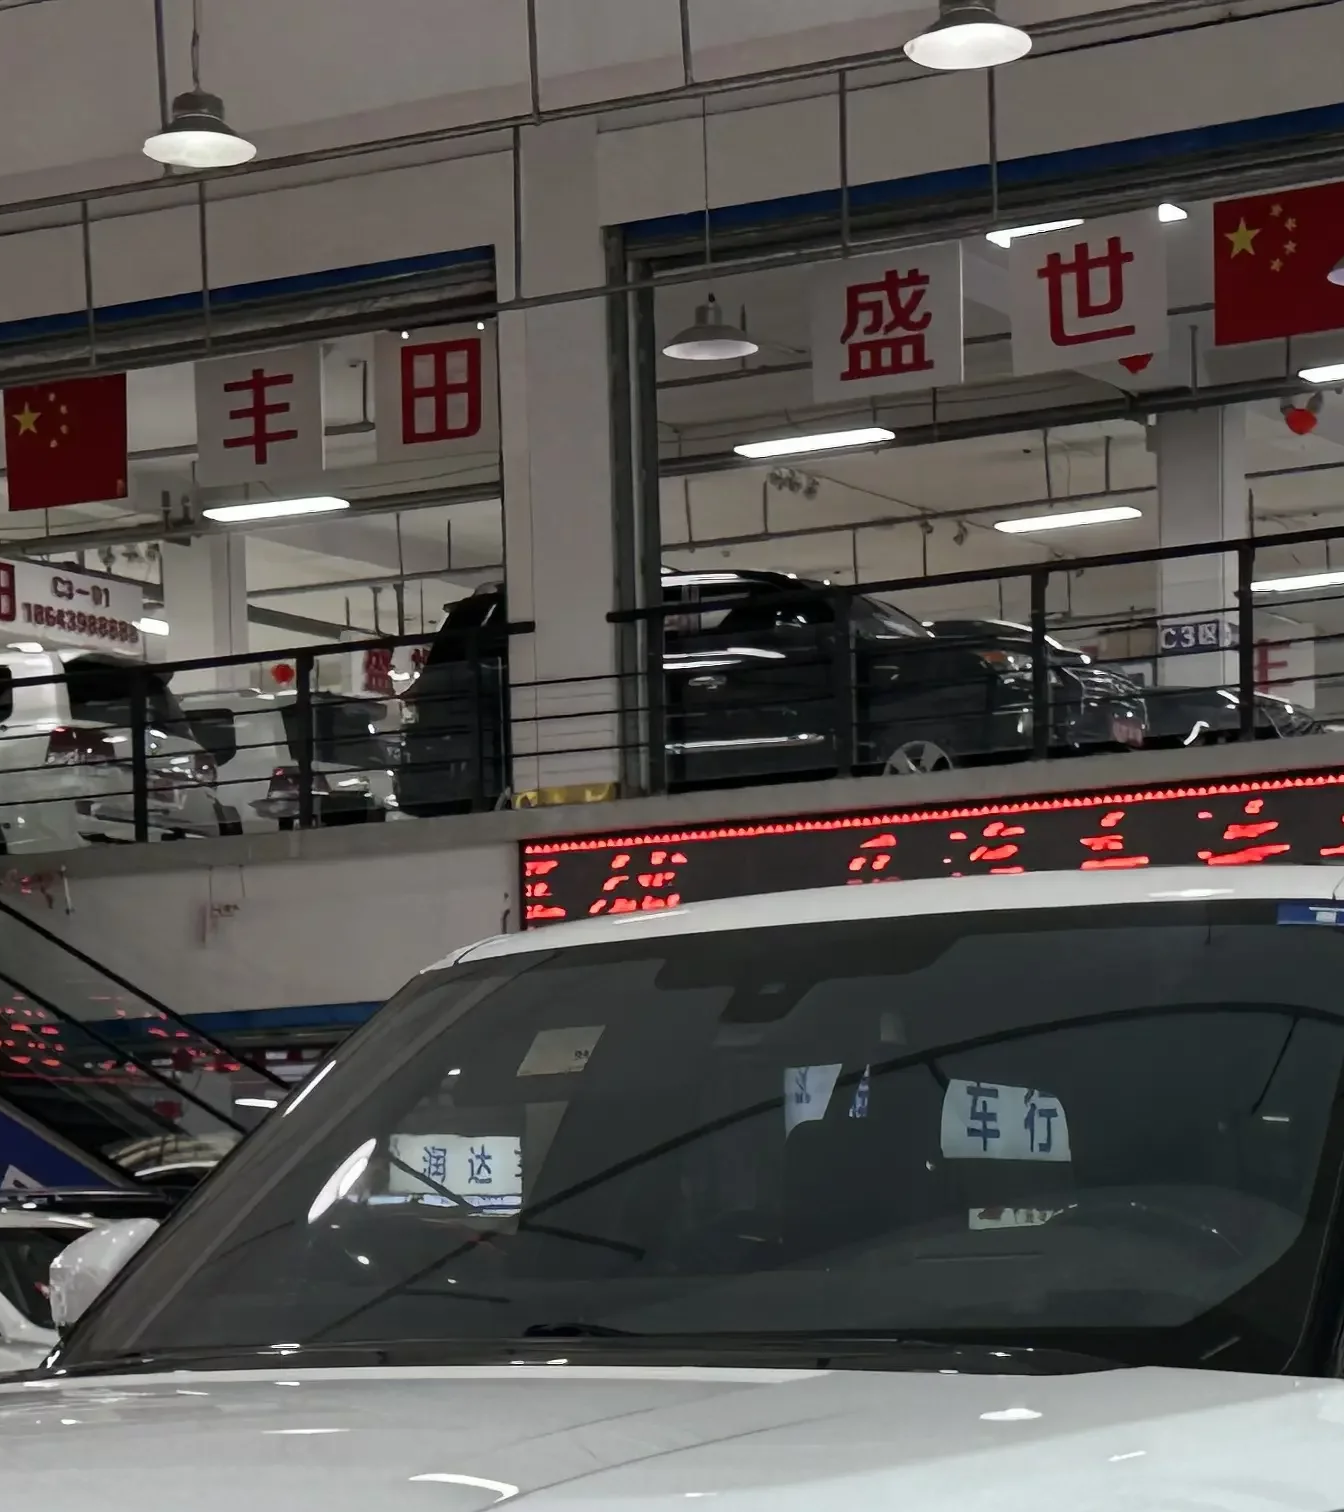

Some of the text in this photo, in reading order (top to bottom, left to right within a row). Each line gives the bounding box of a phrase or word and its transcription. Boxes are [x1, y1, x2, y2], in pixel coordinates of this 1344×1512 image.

[840, 268, 934, 382] 盛
[1036, 235, 1136, 347] 世
[224, 369, 296, 464] 丰
[398, 335, 483, 446] 田
[422, 1143, 522, 1184] 润达
